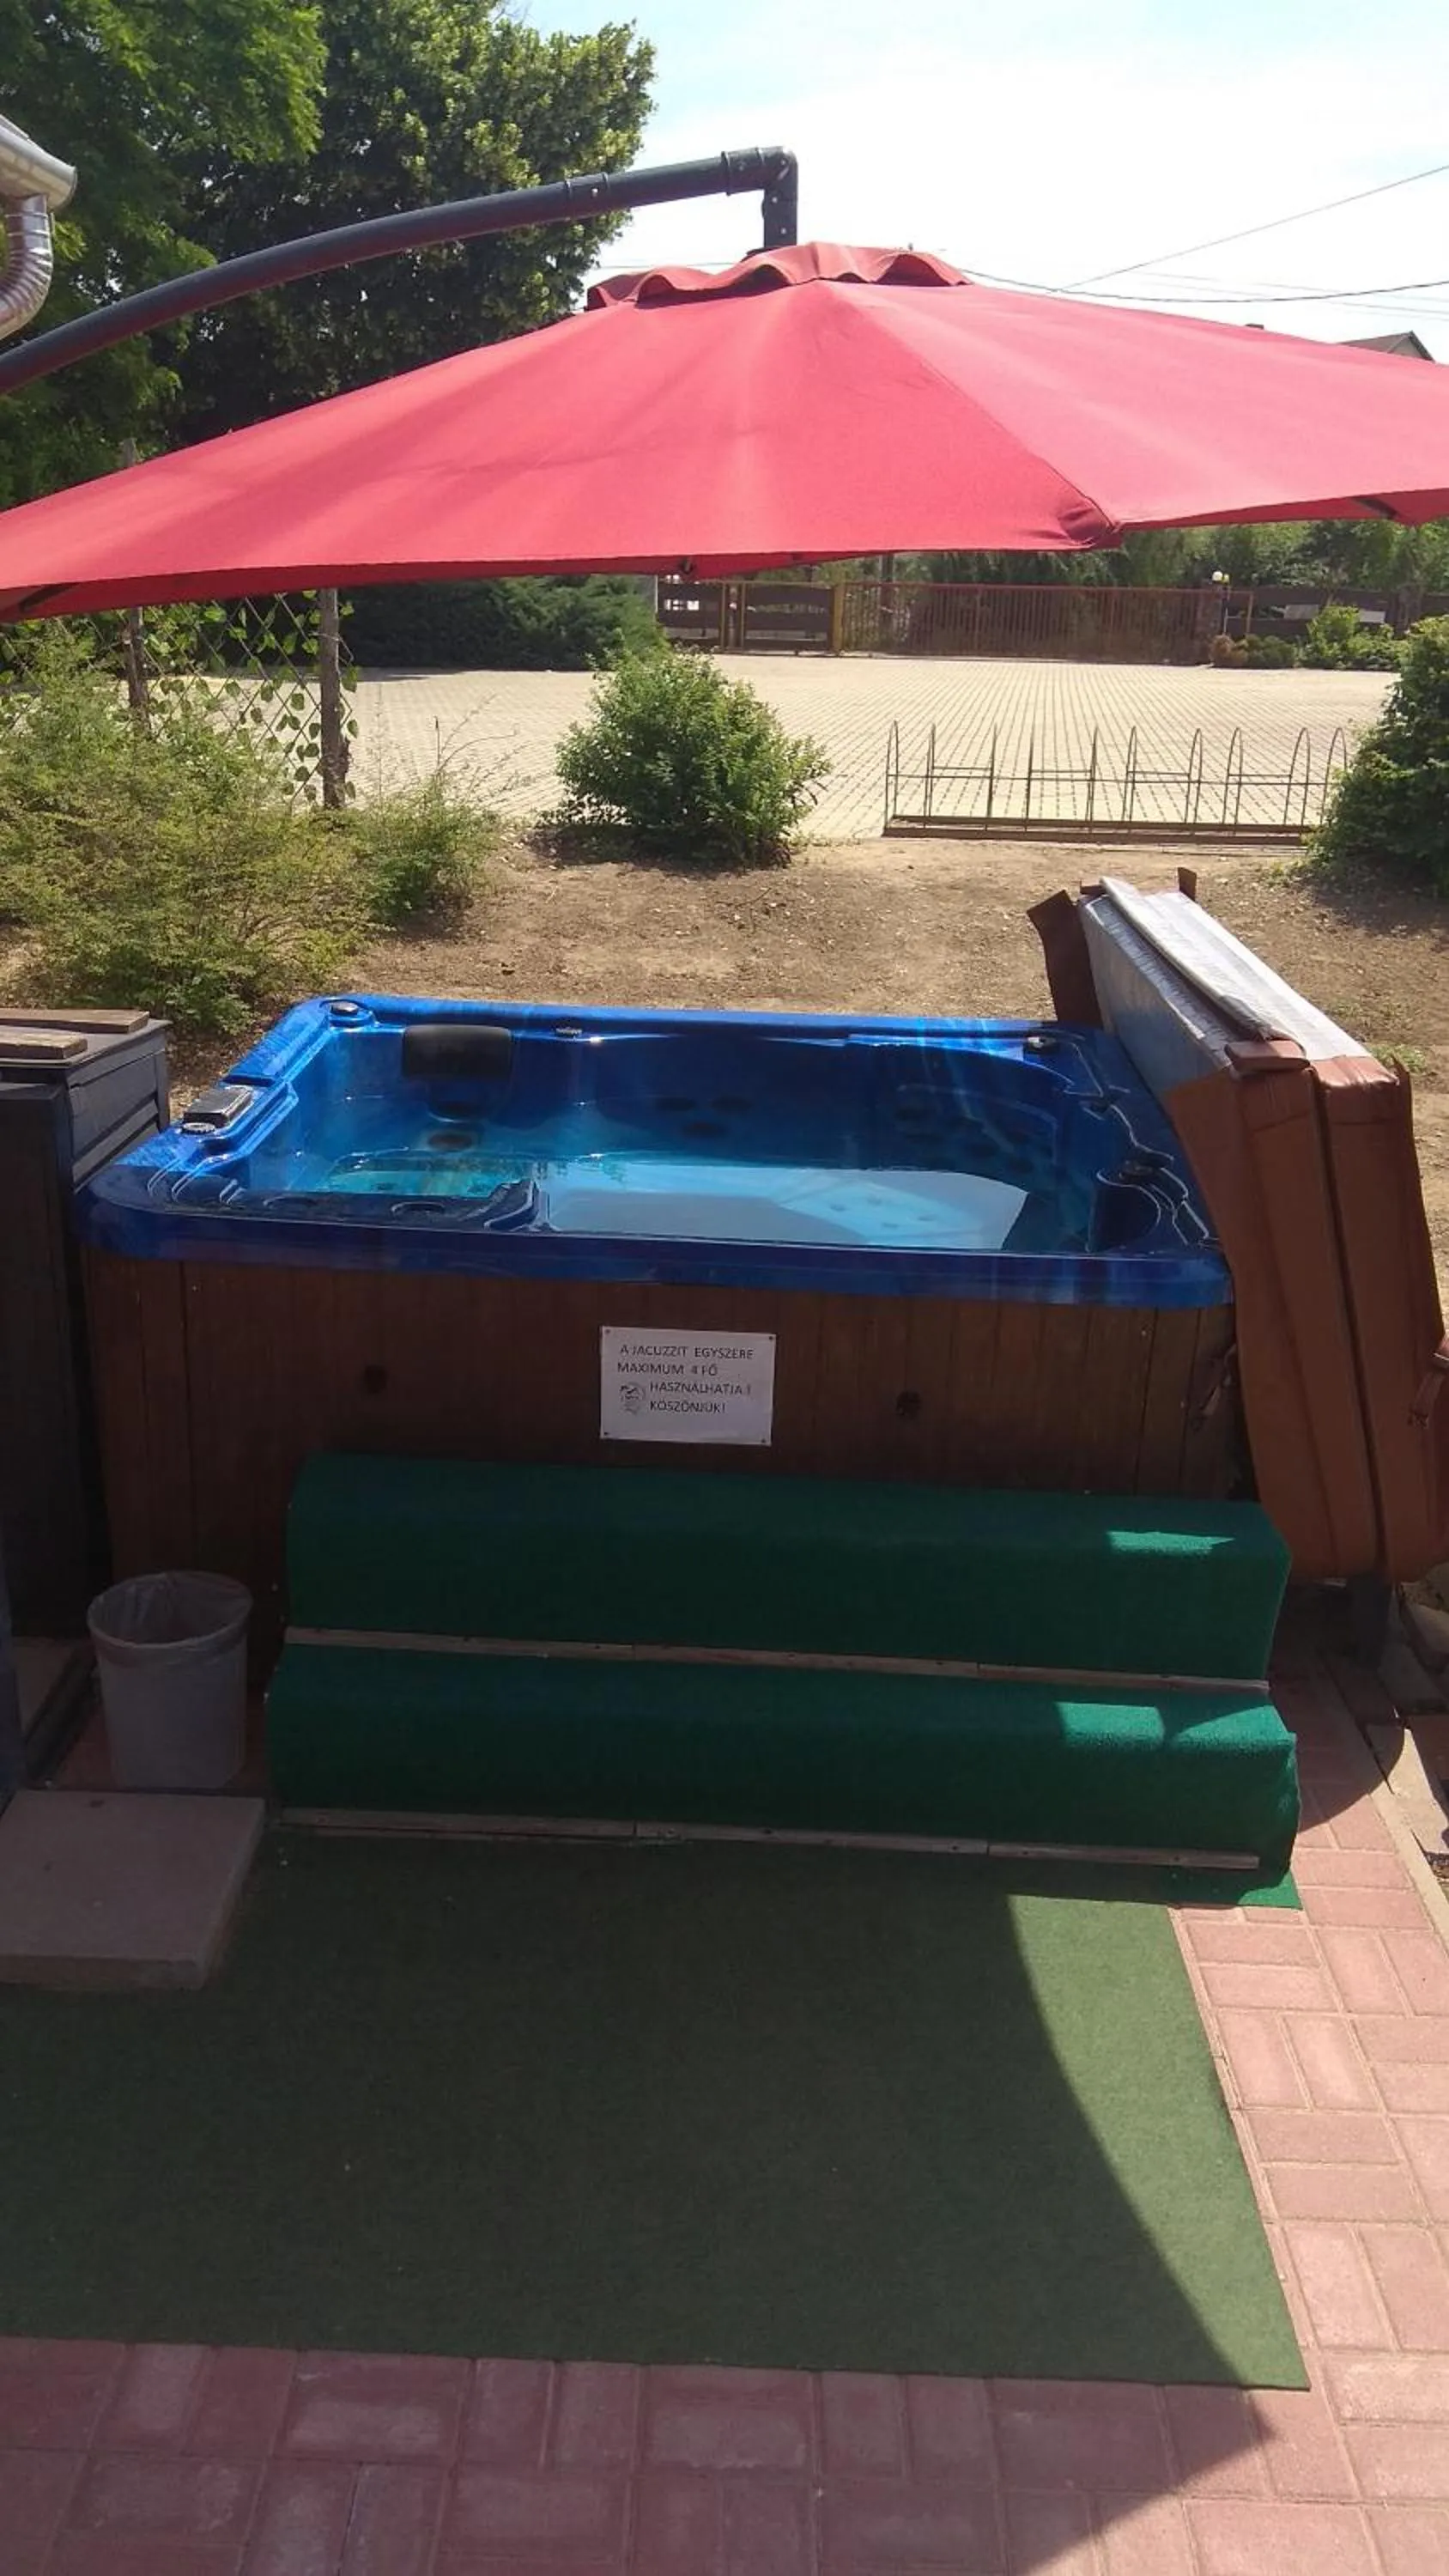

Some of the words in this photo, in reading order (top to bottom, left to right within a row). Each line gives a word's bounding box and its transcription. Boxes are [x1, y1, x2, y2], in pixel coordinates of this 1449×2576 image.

[621, 1345, 629, 1354] A
[631, 1345, 689, 1358] JACUZZIT
[694, 1346, 755, 1359] EGYSZERE
[617, 1363, 684, 1375] MAXIMUM
